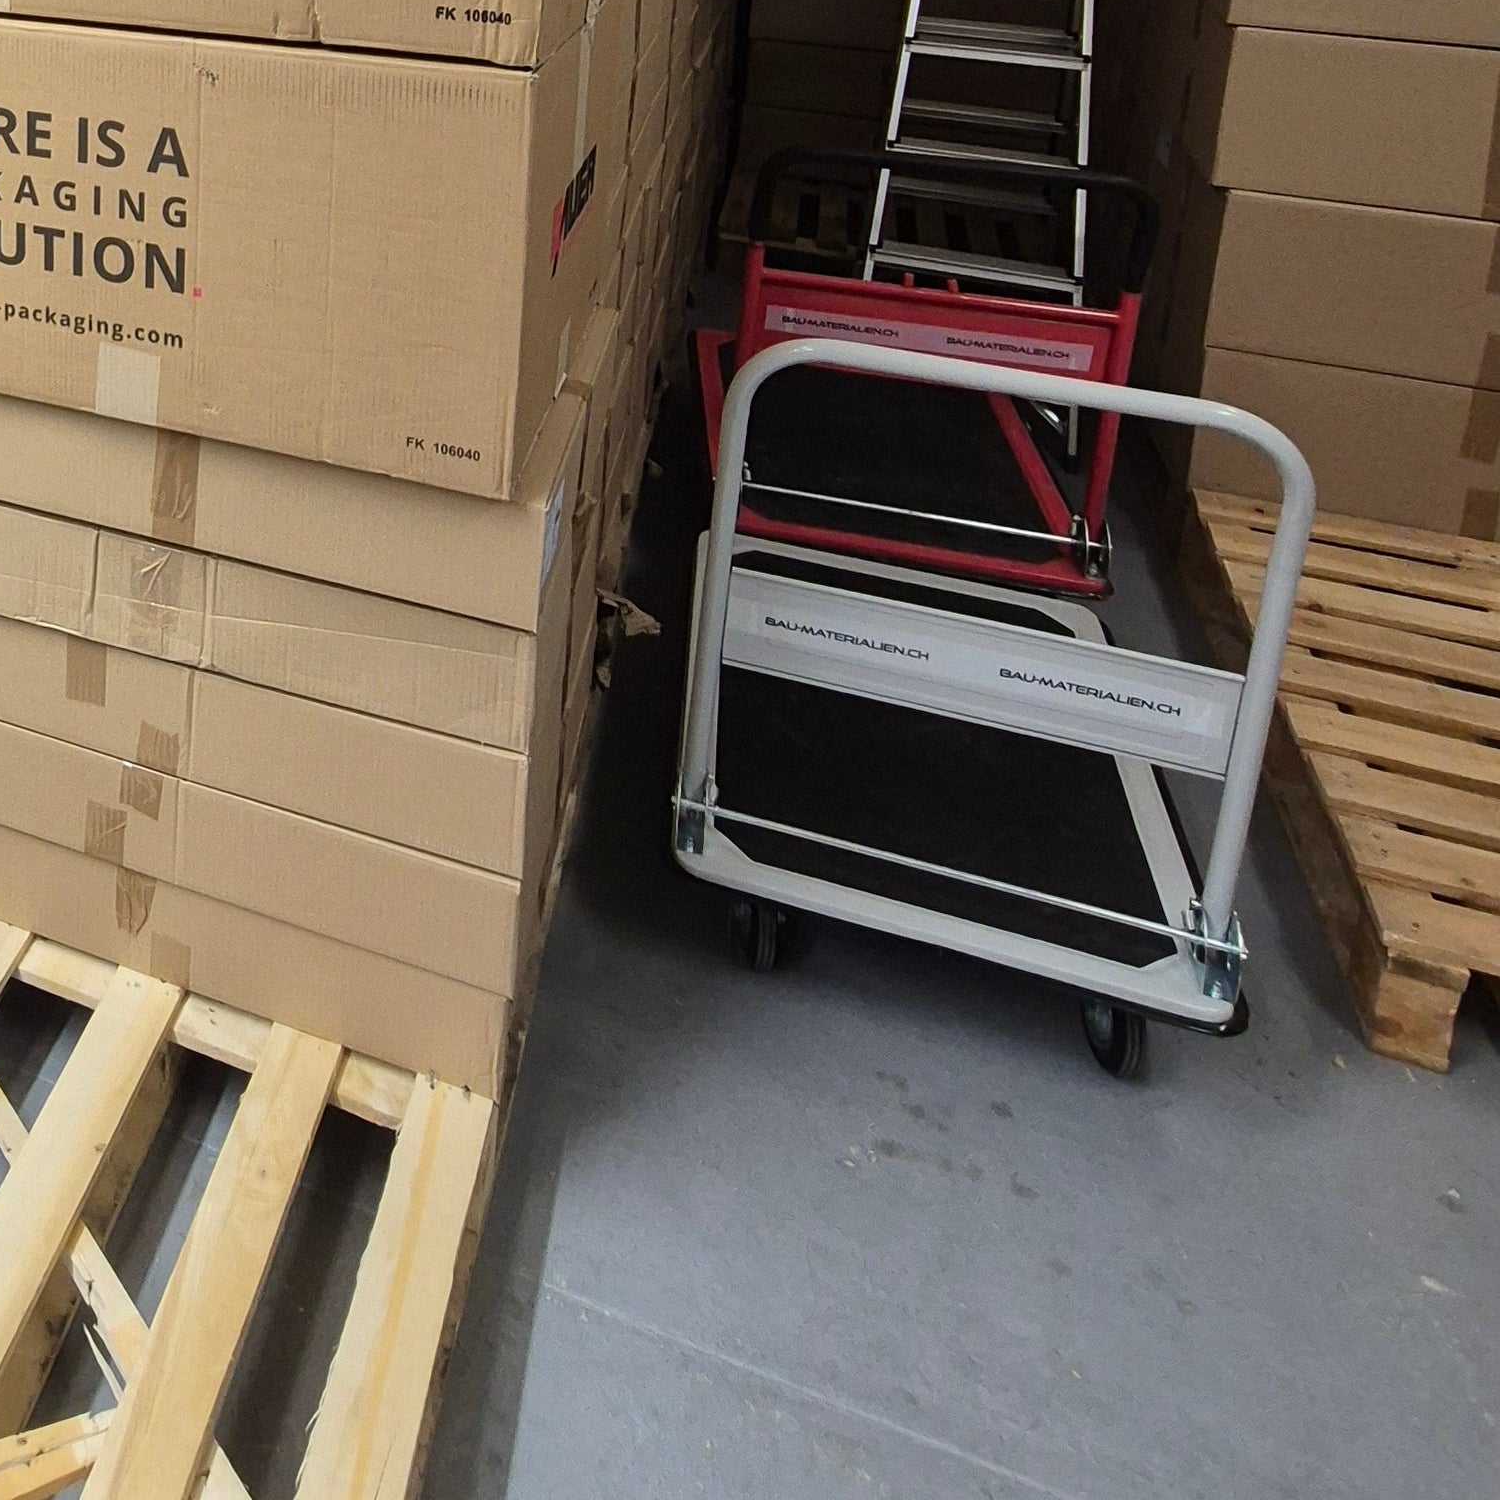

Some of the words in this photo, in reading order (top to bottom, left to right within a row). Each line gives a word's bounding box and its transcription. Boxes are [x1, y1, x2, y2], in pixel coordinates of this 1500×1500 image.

[435, 6, 456, 21] FK
[464, 8, 512, 25] 106040
[77, 117, 125, 168] IS
[147, 127, 190, 178] A
[782, 314, 899, 338] BAU-MATERIALIEN.CH
[946, 336, 1071, 359] BAU-MATERIALIEN.CH
[406, 436, 425, 451] FK
[433, 442, 481, 462] 106040
[765, 616, 929, 661] BAU-MATERIALIEN.CH
[1000, 668, 1181, 717] BAU-MATERIALIEN.CH
